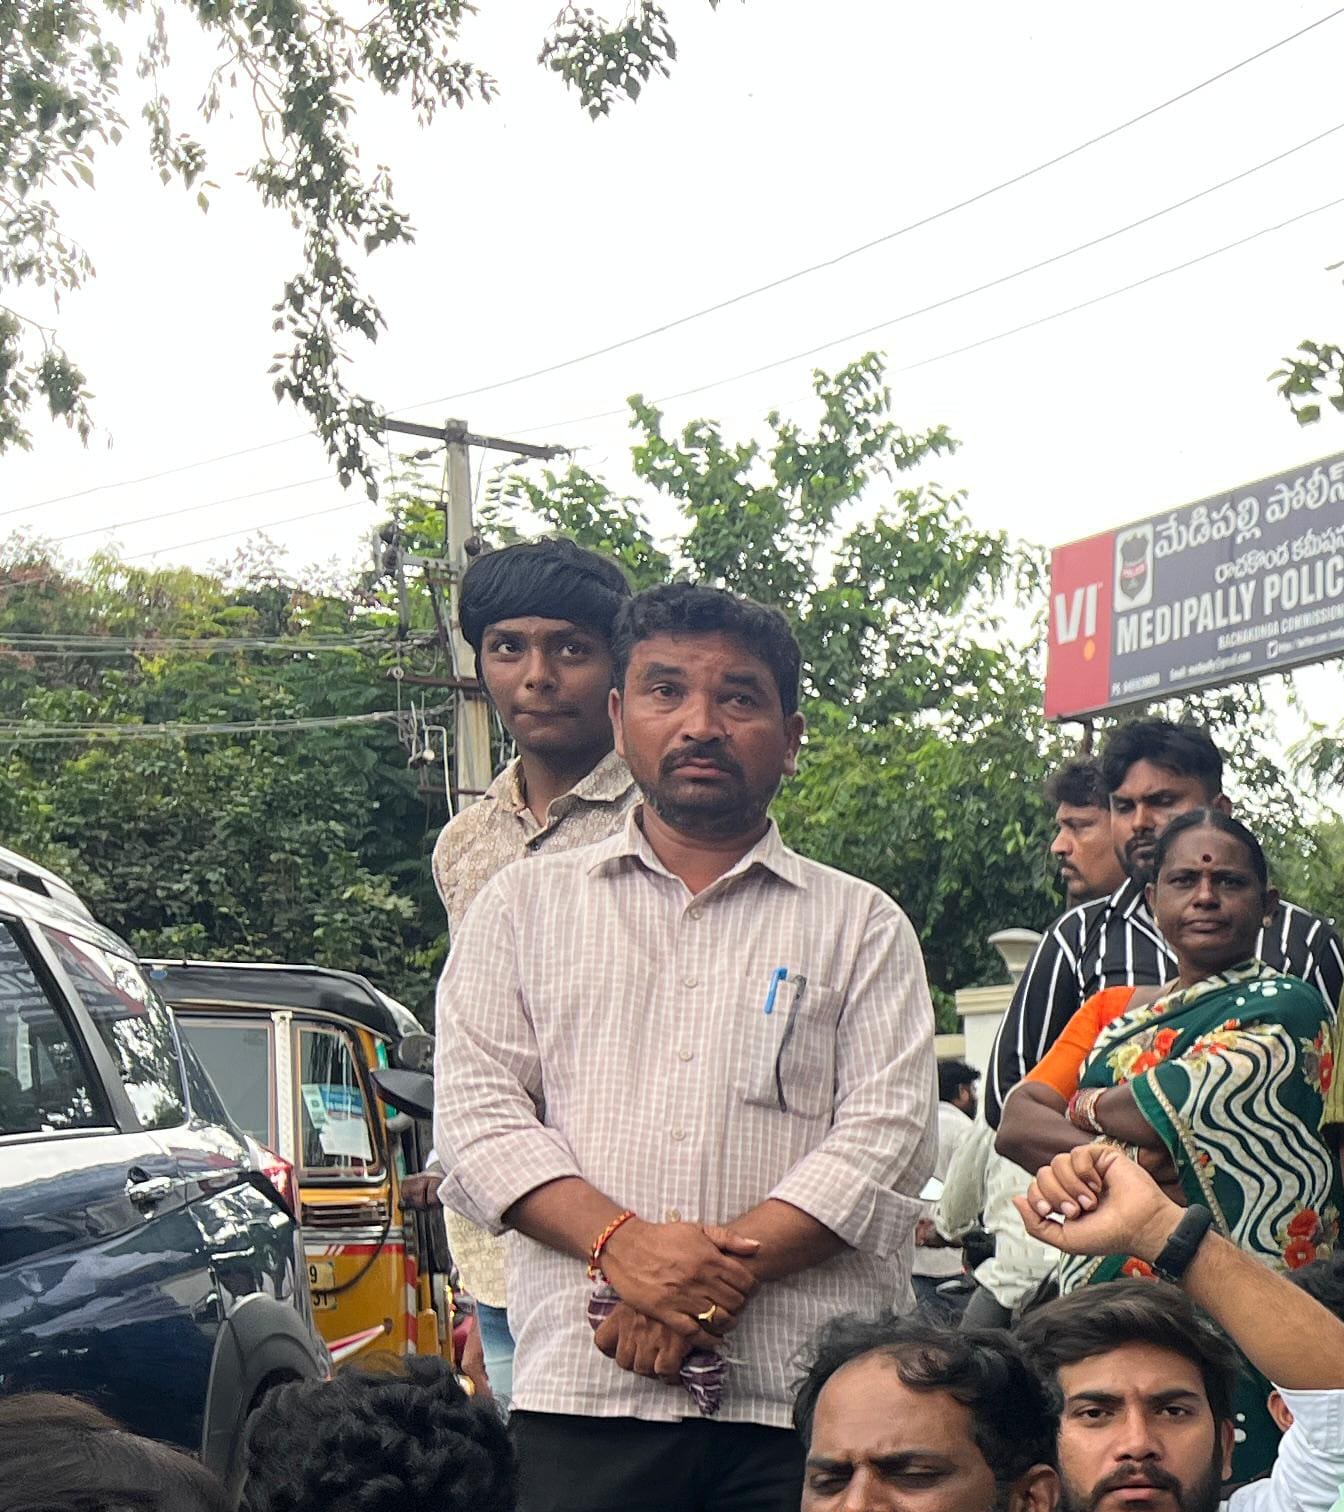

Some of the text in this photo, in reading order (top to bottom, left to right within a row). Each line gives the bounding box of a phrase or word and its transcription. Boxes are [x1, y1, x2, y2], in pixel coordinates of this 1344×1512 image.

[1154, 496, 1263, 559] మేడిపల్లి
[1116, 579, 1257, 656] MEDIPALLY
[1217, 621, 1280, 651] RACHAKONDA
